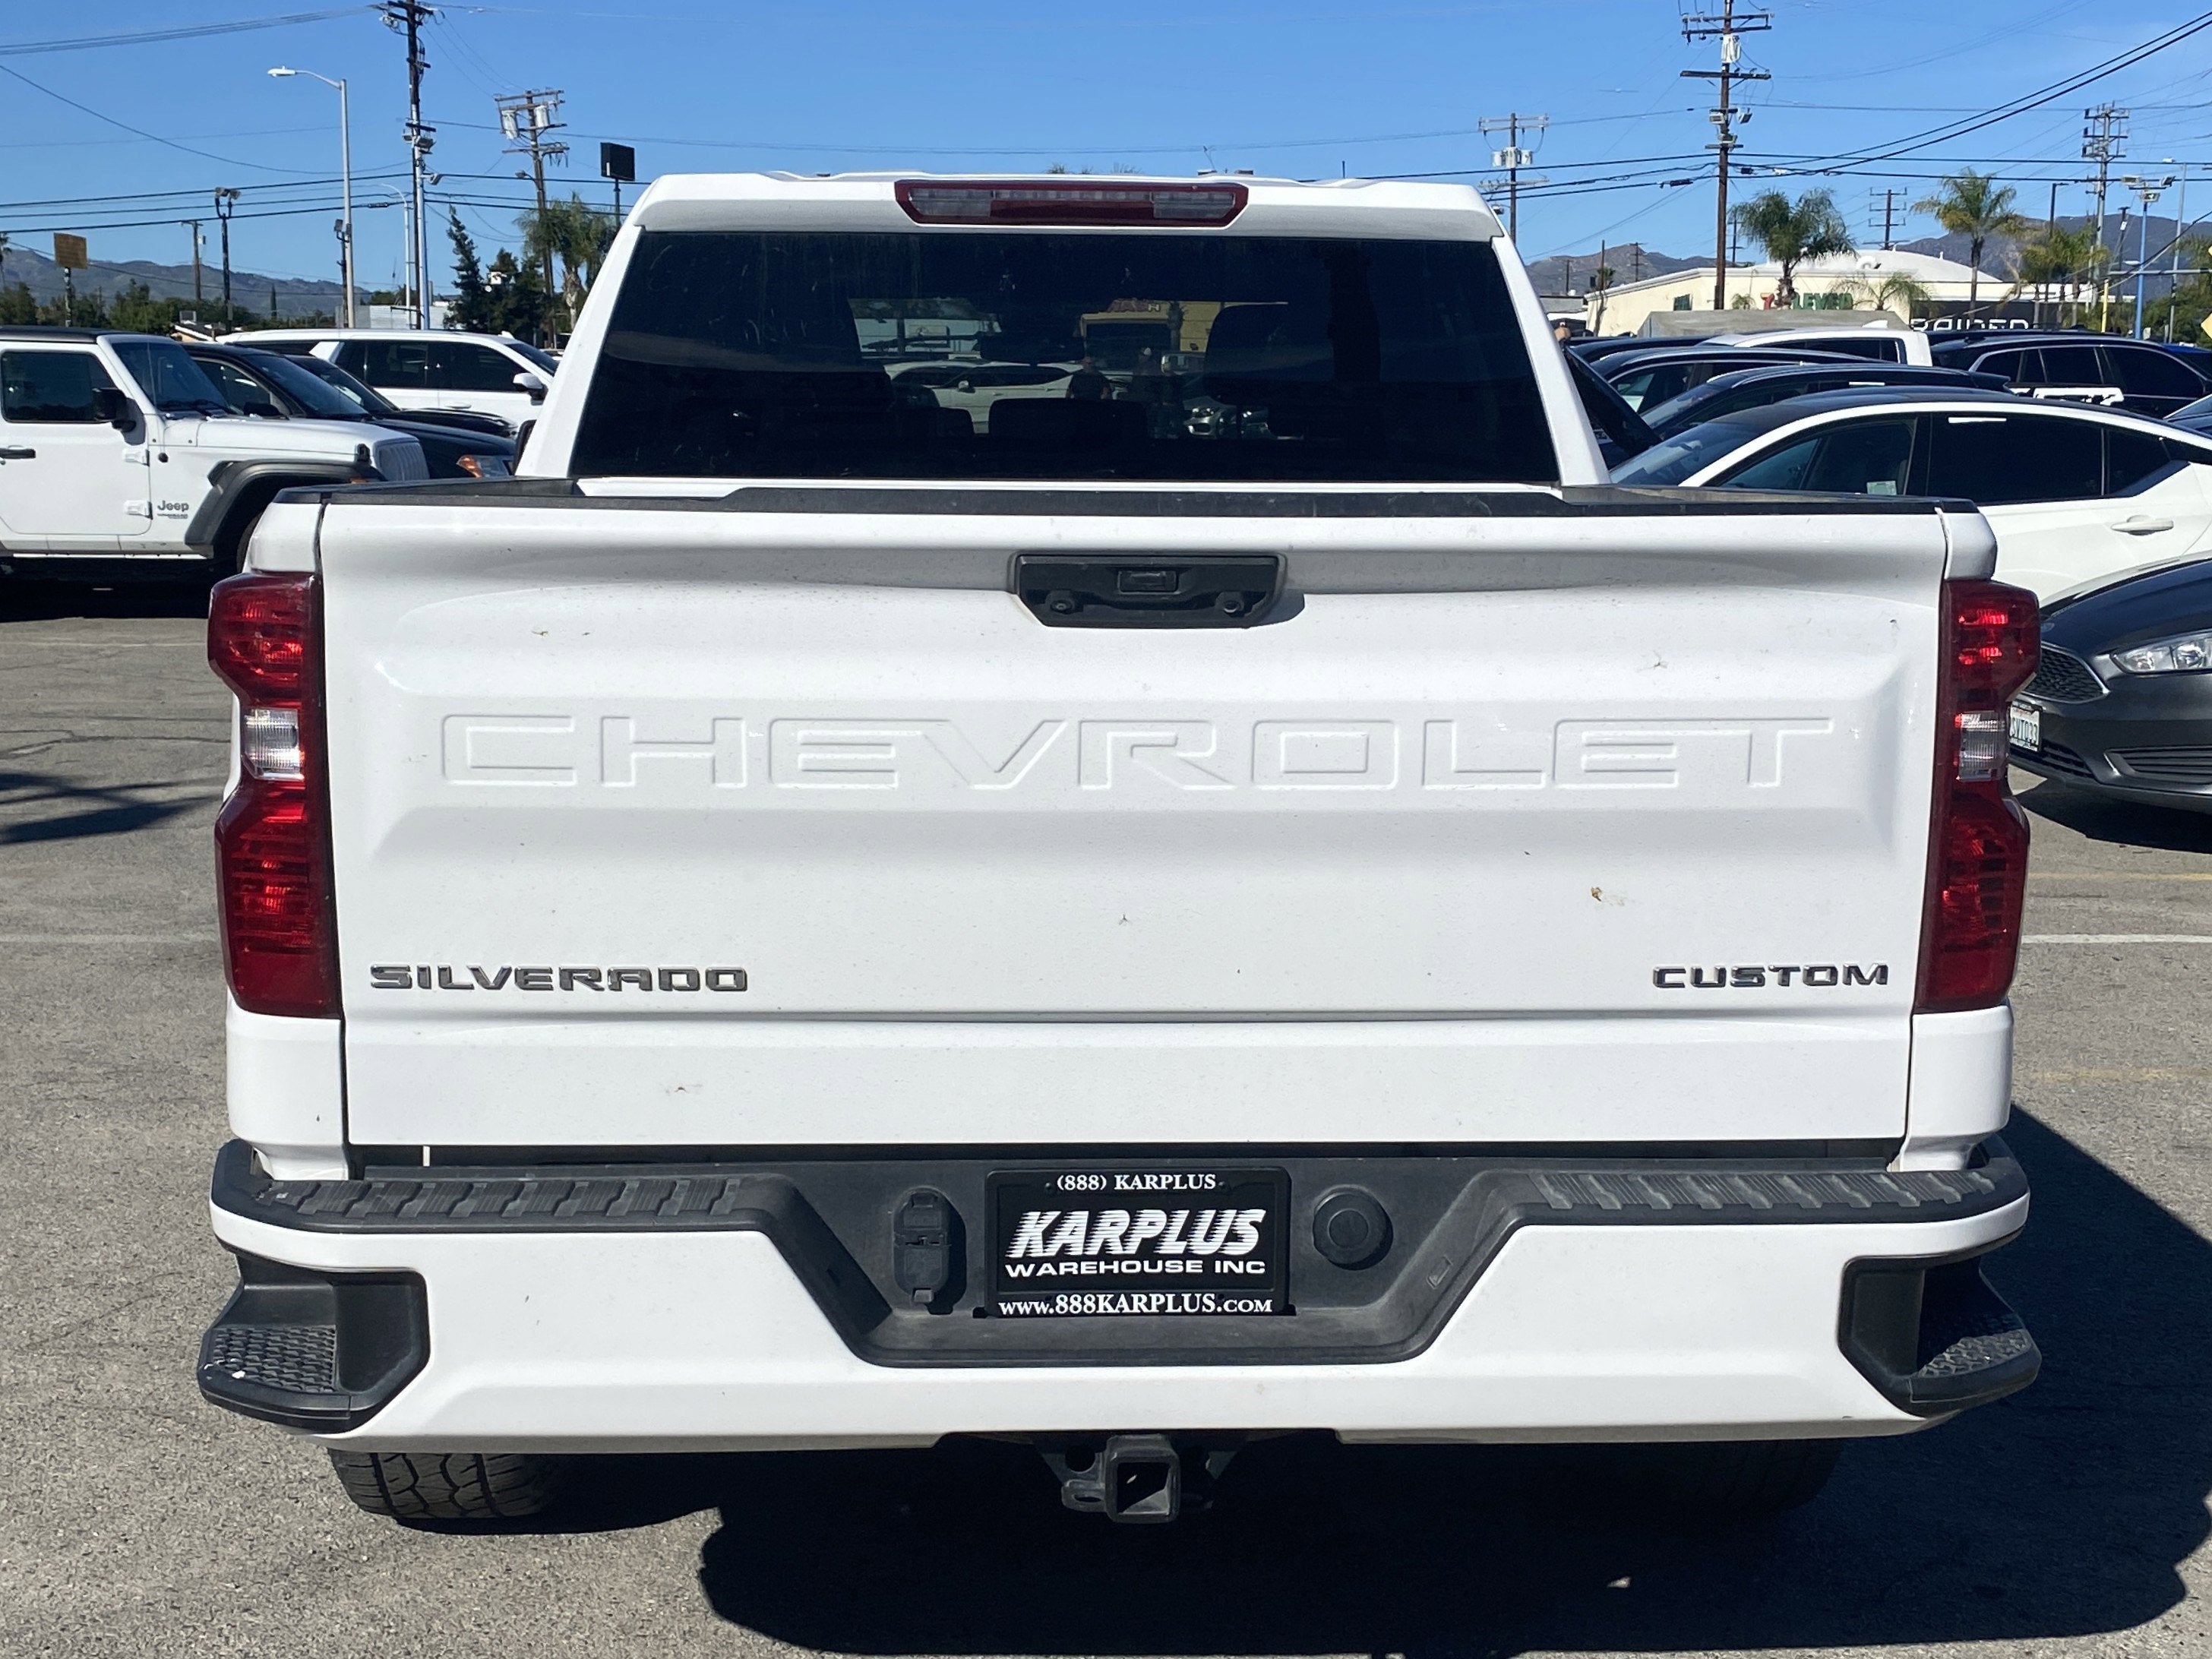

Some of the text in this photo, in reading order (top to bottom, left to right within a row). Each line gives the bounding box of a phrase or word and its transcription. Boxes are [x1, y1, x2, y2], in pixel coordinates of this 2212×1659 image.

[157, 500, 189, 512] Jeep
[442, 715, 1834, 791] CHEVROLET
[370, 963, 748, 991] SILVERADO
[1653, 962, 1889, 988] CUSTOM
[1057, 1174, 1216, 1191] (888) KARPLUS
[1005, 1209, 1266, 1259] KARPLUS
[1004, 1259, 1266, 1278] WAREHOUSE INC
